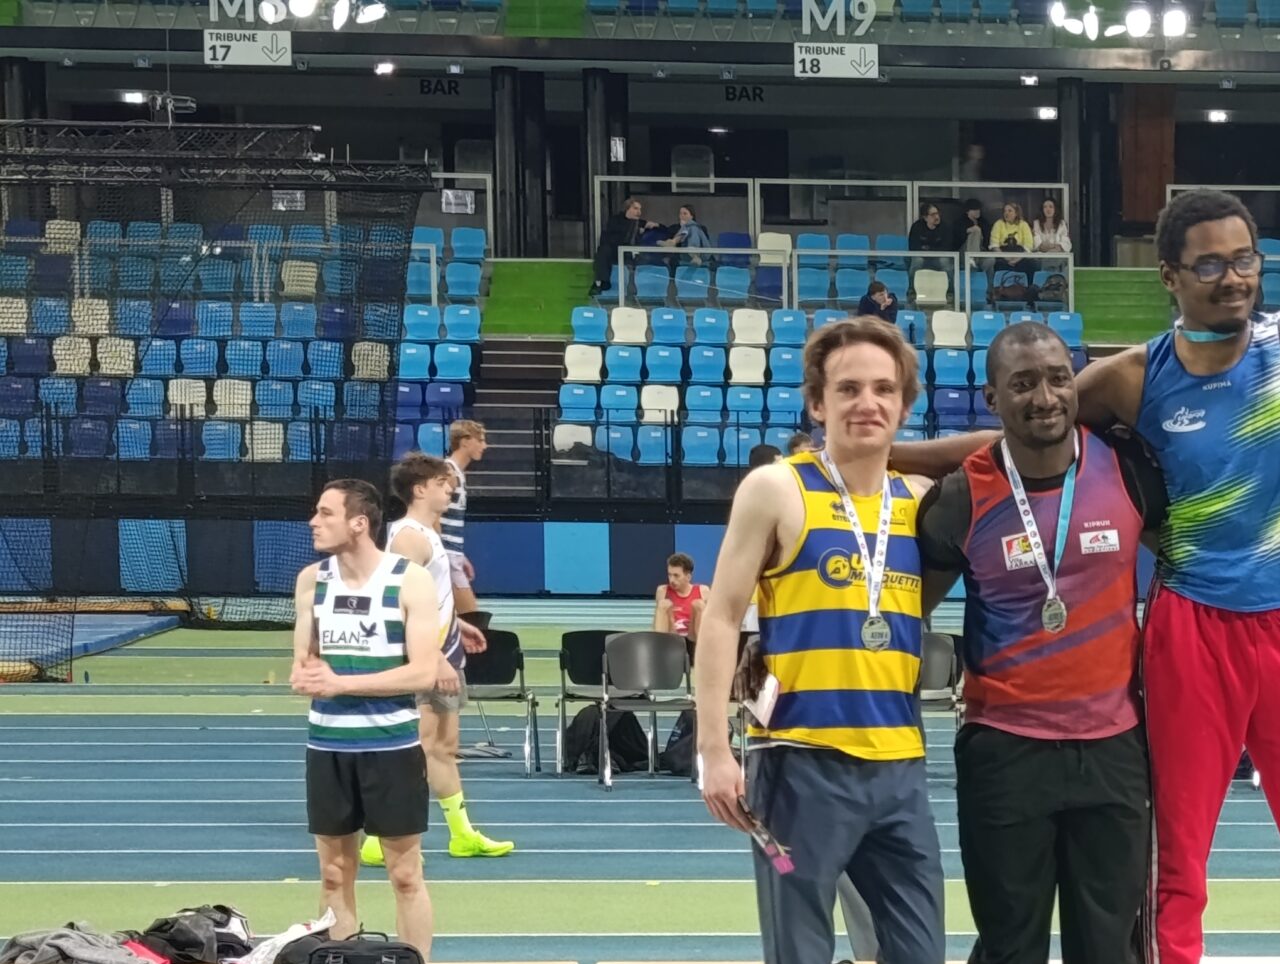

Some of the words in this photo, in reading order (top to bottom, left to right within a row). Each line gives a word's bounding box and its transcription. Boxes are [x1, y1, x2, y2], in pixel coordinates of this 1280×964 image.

[801, 0, 877, 36] M9
[208, 32, 258, 42] TRIBUNE
[207, 45, 231, 61] 17
[797, 45, 846, 56] TRIBUNE
[798, 58, 821, 74] 18
[419, 79, 460, 95] BAR
[725, 85, 764, 101] BAR
[850, 570, 920, 589] MQUETTE
[322, 630, 361, 644] ELAN
